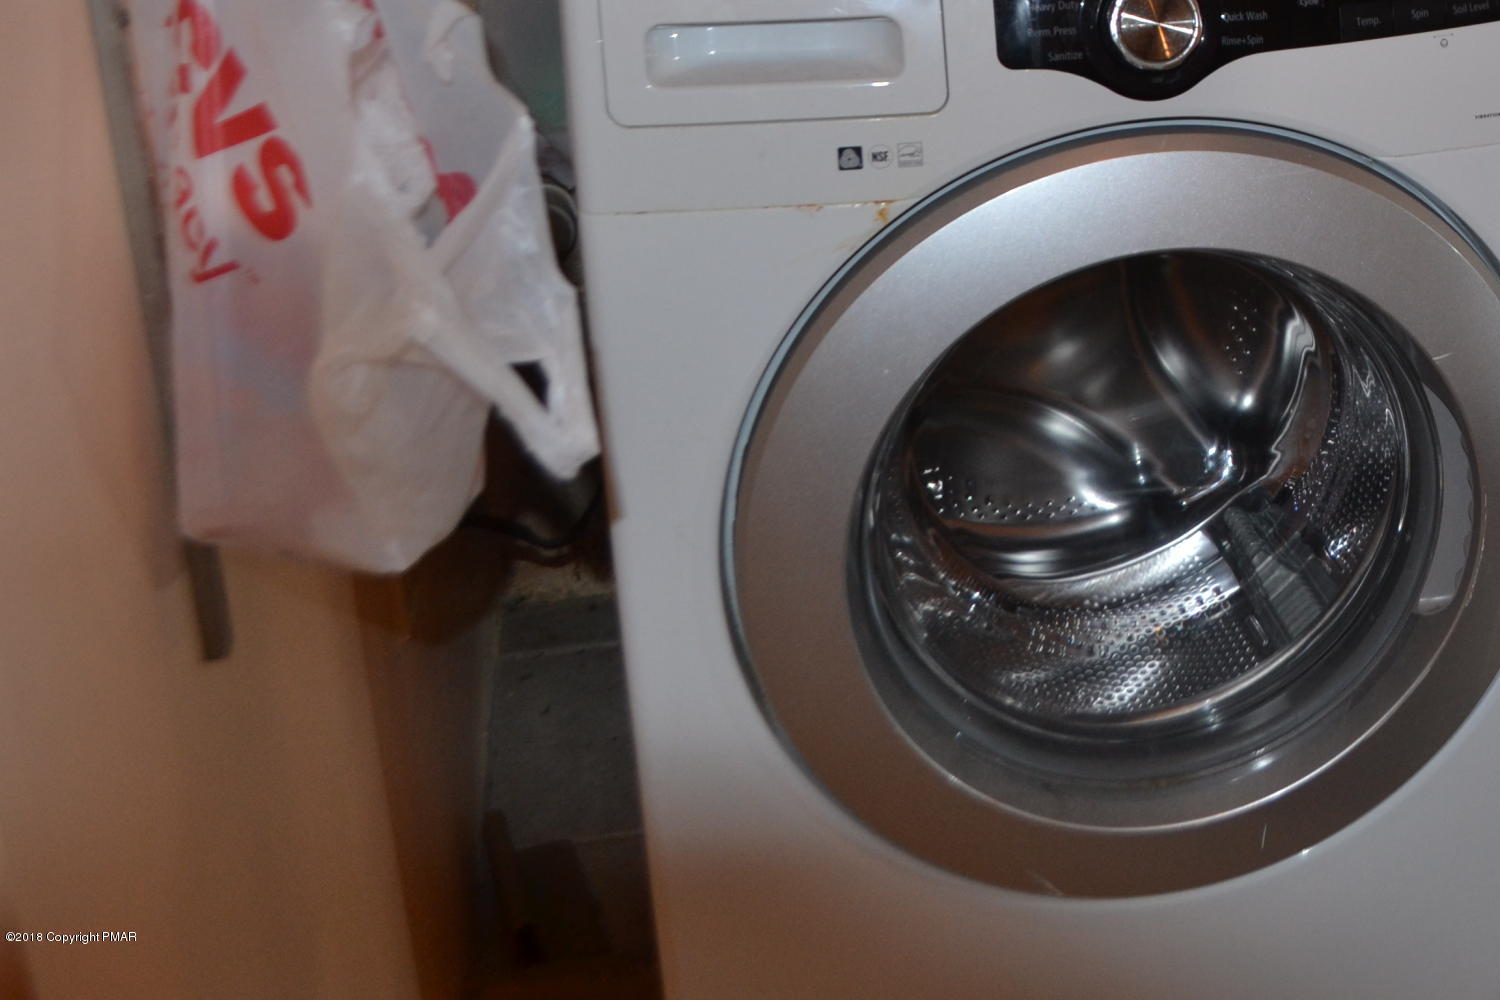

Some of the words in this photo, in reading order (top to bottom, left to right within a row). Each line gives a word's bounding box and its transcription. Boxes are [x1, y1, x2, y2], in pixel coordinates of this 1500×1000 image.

[1410, 8, 1430, 20] Spin
[1452, 3, 1468, 15] Soil
[1469, 1, 1490, 13] Level
[1245, 10, 1268, 21] Wash
